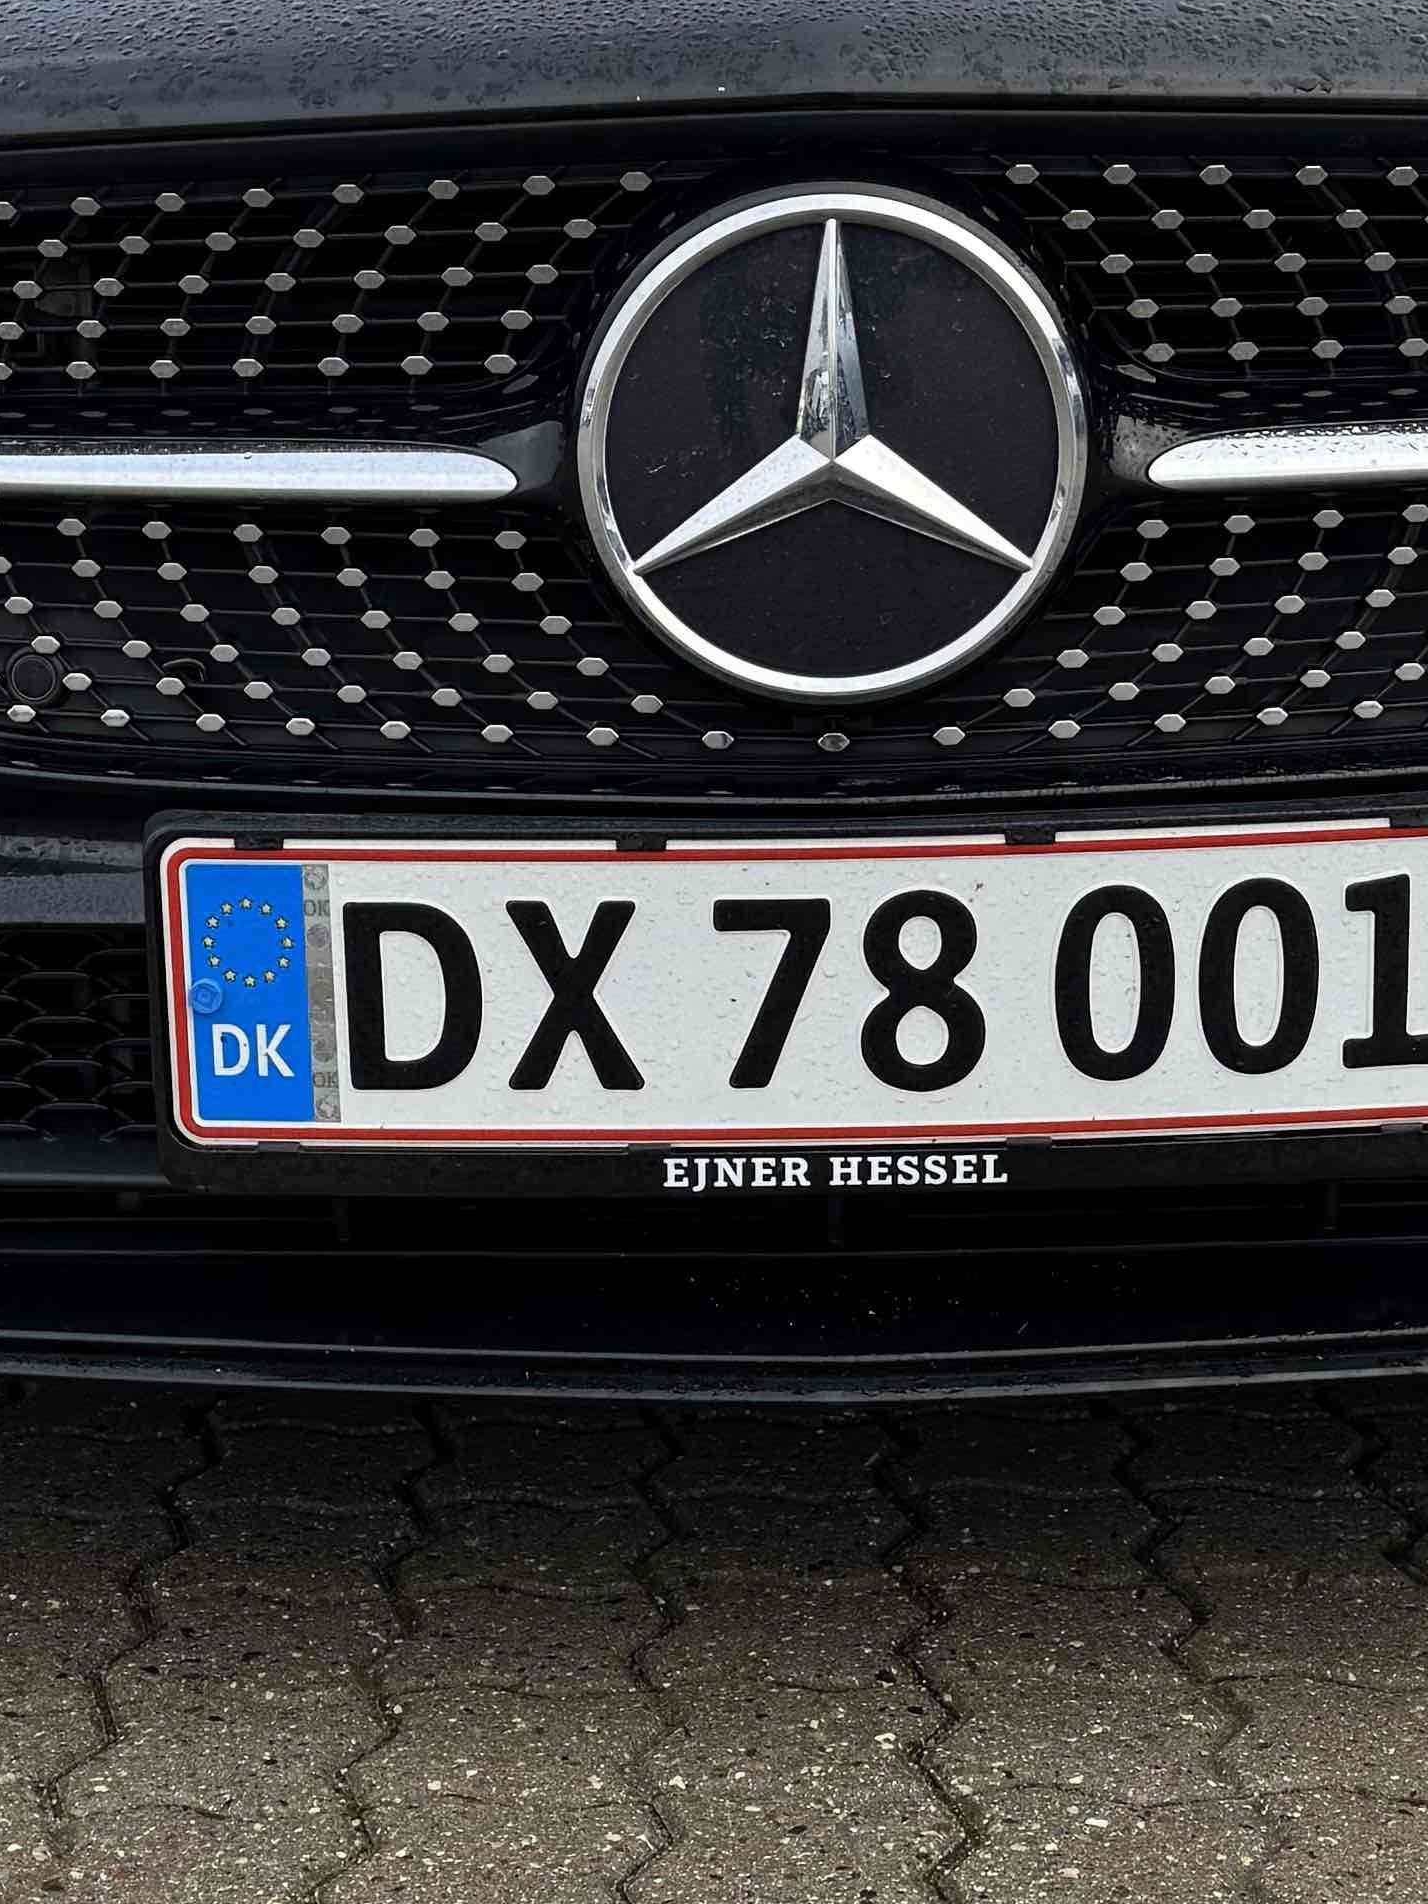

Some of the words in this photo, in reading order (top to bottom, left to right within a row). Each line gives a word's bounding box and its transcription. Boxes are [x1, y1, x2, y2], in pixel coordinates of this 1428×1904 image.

[343, 901, 645, 1091] DX
[713, 888, 985, 1092] 78
[212, 1023, 295, 1077] DK
[663, 1157, 811, 1193] EJNER
[829, 1154, 1008, 1186] HESSEL
